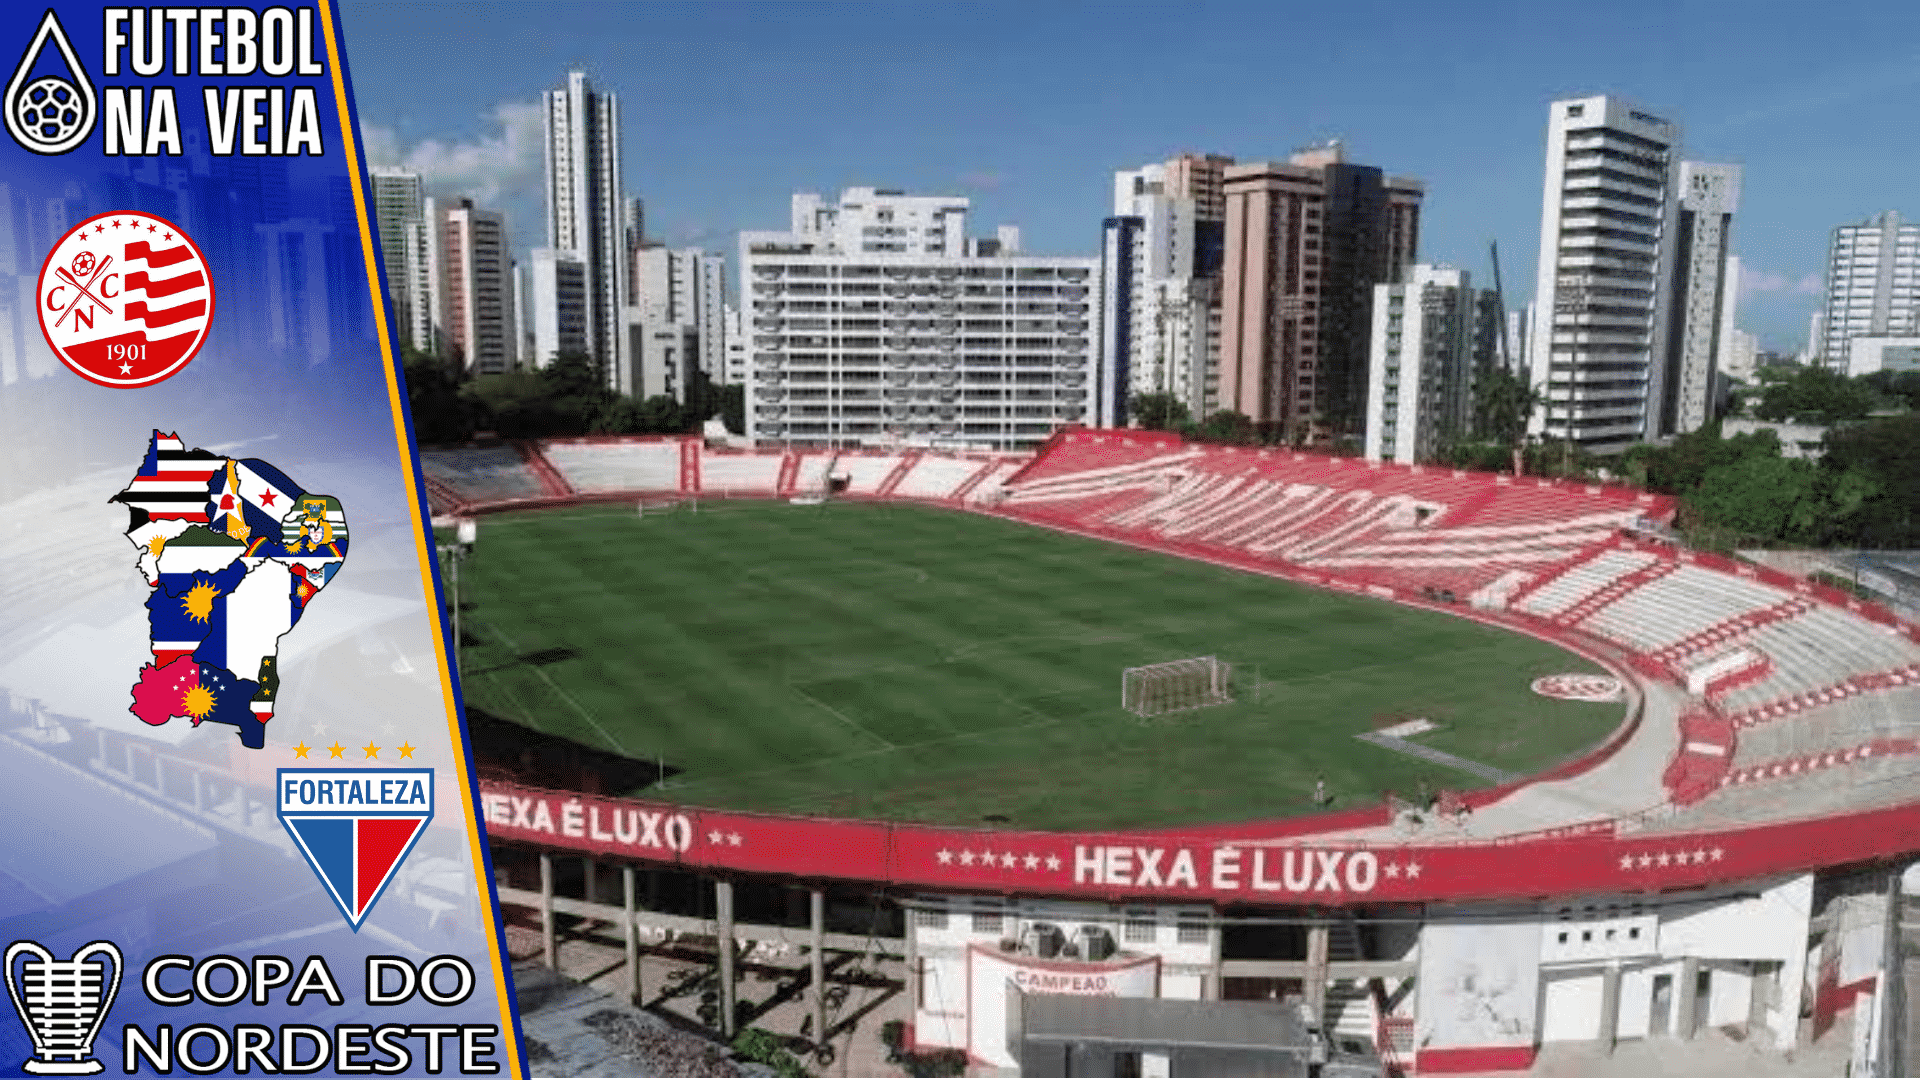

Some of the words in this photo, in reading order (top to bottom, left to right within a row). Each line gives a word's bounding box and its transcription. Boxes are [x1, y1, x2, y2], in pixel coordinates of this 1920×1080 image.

[561, 798, 585, 837] É
[589, 806, 692, 852] LUXO
[1074, 844, 1199, 888] HEXA
[1212, 845, 1242, 890] É
[1252, 849, 1379, 892] LUXO
